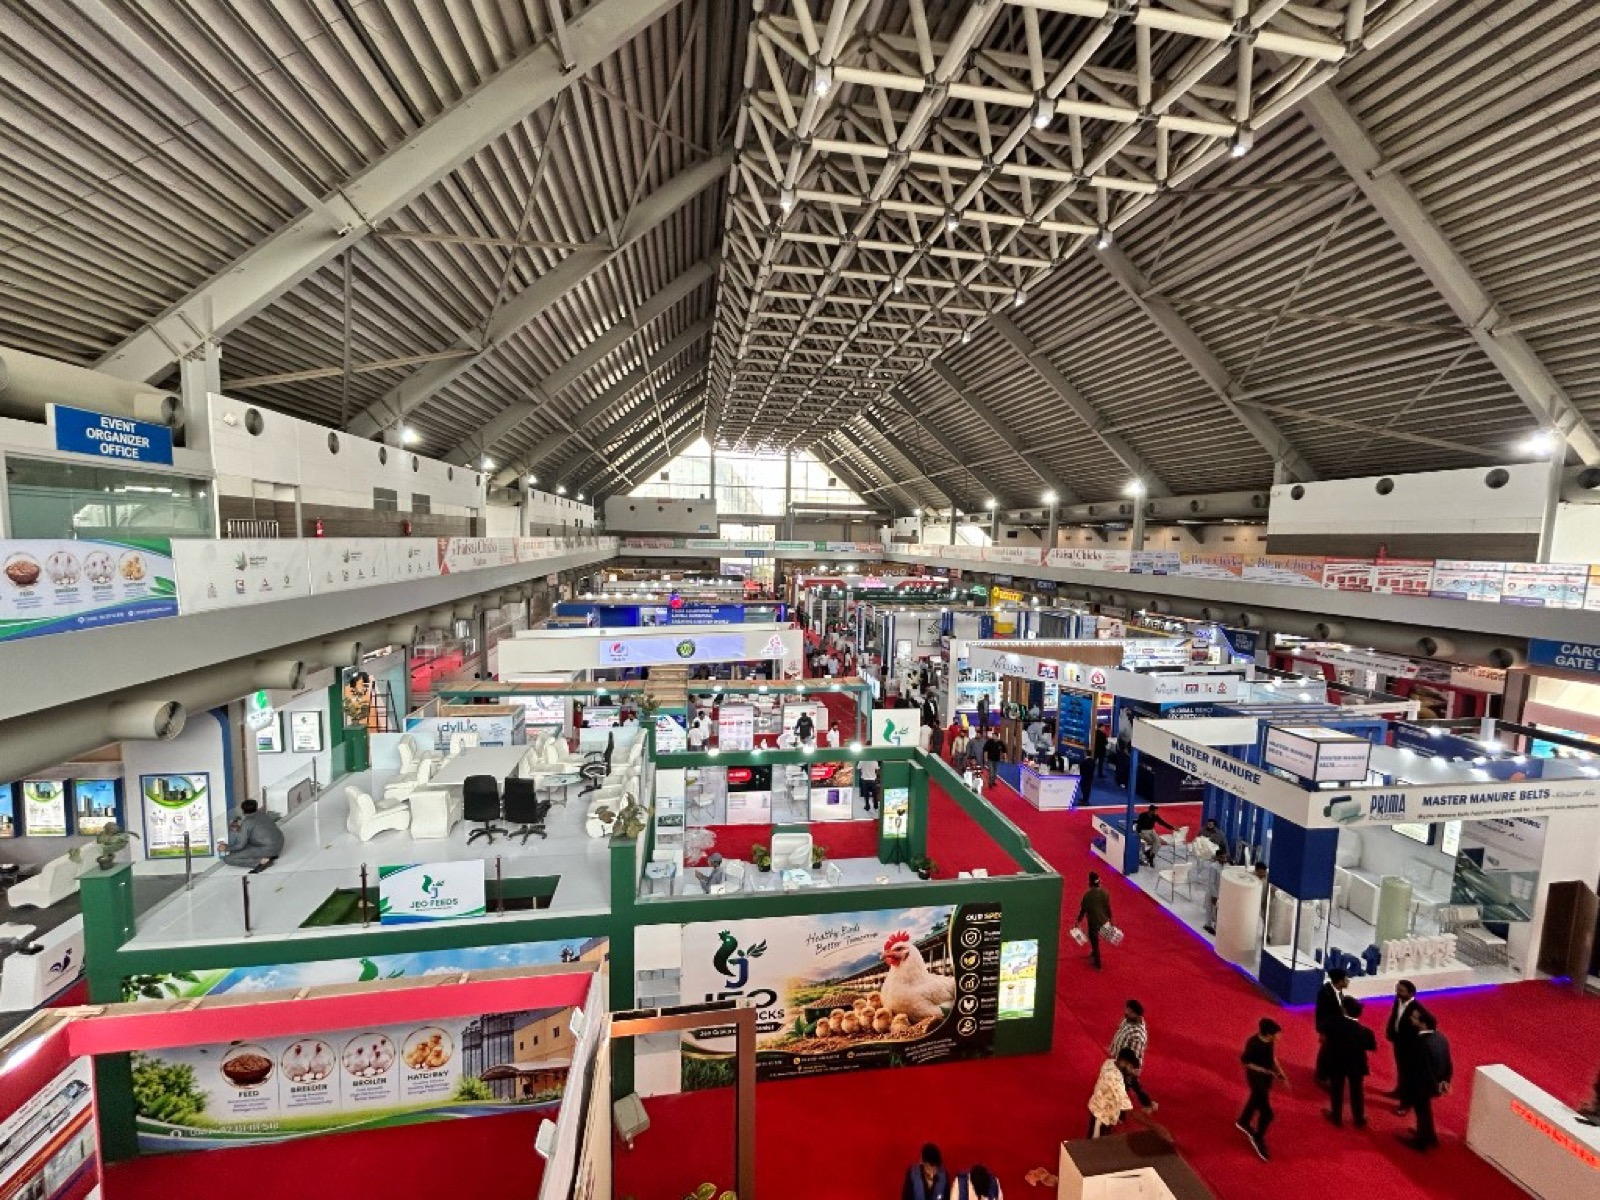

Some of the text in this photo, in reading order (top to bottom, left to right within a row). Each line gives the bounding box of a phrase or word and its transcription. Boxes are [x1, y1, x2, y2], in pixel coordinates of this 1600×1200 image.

[101, 416, 136, 433] EVENT
[86, 427, 149, 448] ORGANIZER
[100, 442, 139, 459] OFFICE
[1076, 550, 1102, 560] Chicks
[1555, 655, 1595, 670] GATE
[1169, 752, 1198, 773] BELTS
[1171, 739, 1261, 785] MASTER MANURE
[1370, 794, 1405, 814] PRIMA
[1422, 794, 1467, 806] MASTER
[1469, 790, 1516, 803] MANURE
[1519, 789, 1551, 800] BELTS
[409, 898, 459, 909] JEO FEEDS
[966, 913, 984, 921] OUR
[815, 941, 842, 956] Better
[290, 1083, 328, 1093] BREEDER
[352, 1077, 387, 1087] BROILER
[238, 1090, 259, 1098] FEED
